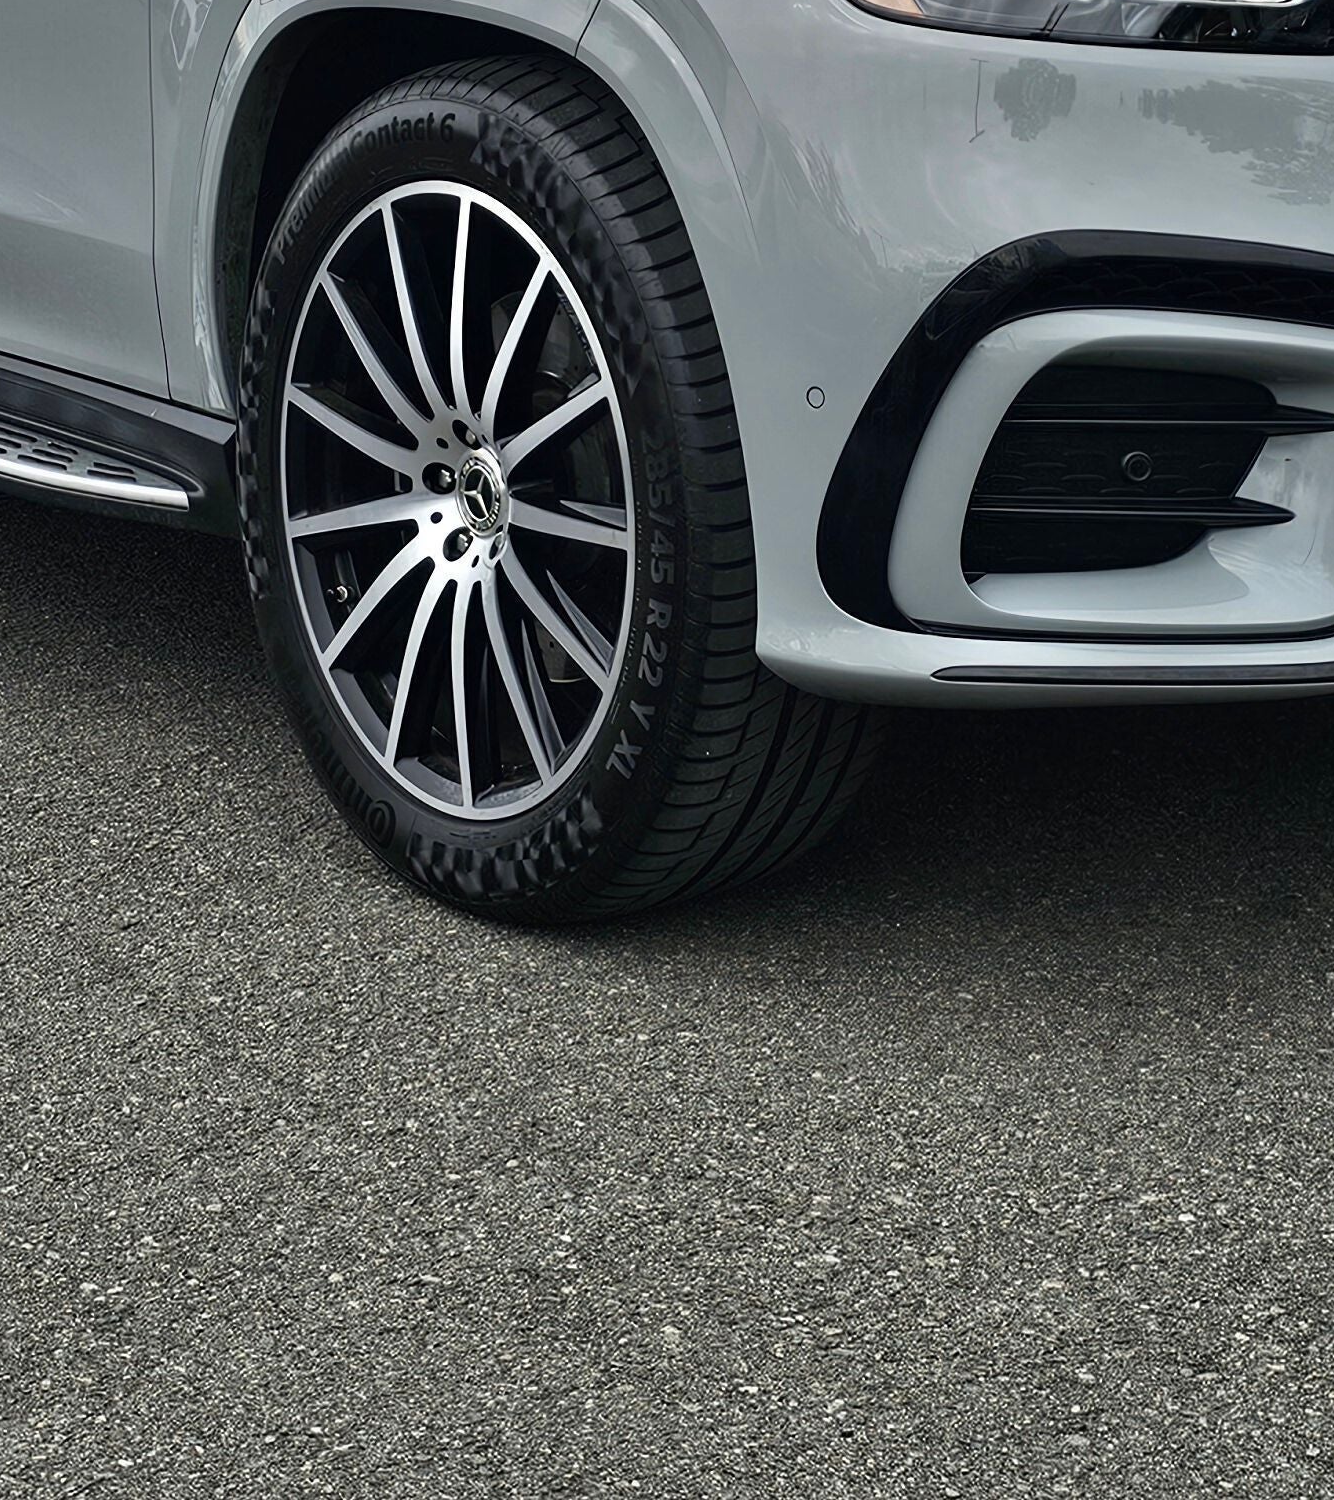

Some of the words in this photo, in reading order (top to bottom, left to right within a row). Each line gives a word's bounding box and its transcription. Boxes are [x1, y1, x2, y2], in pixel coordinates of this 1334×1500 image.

[439, 112, 456, 143] 6
[640, 428, 676, 585] 285/45
[605, 728, 643, 780] XL
